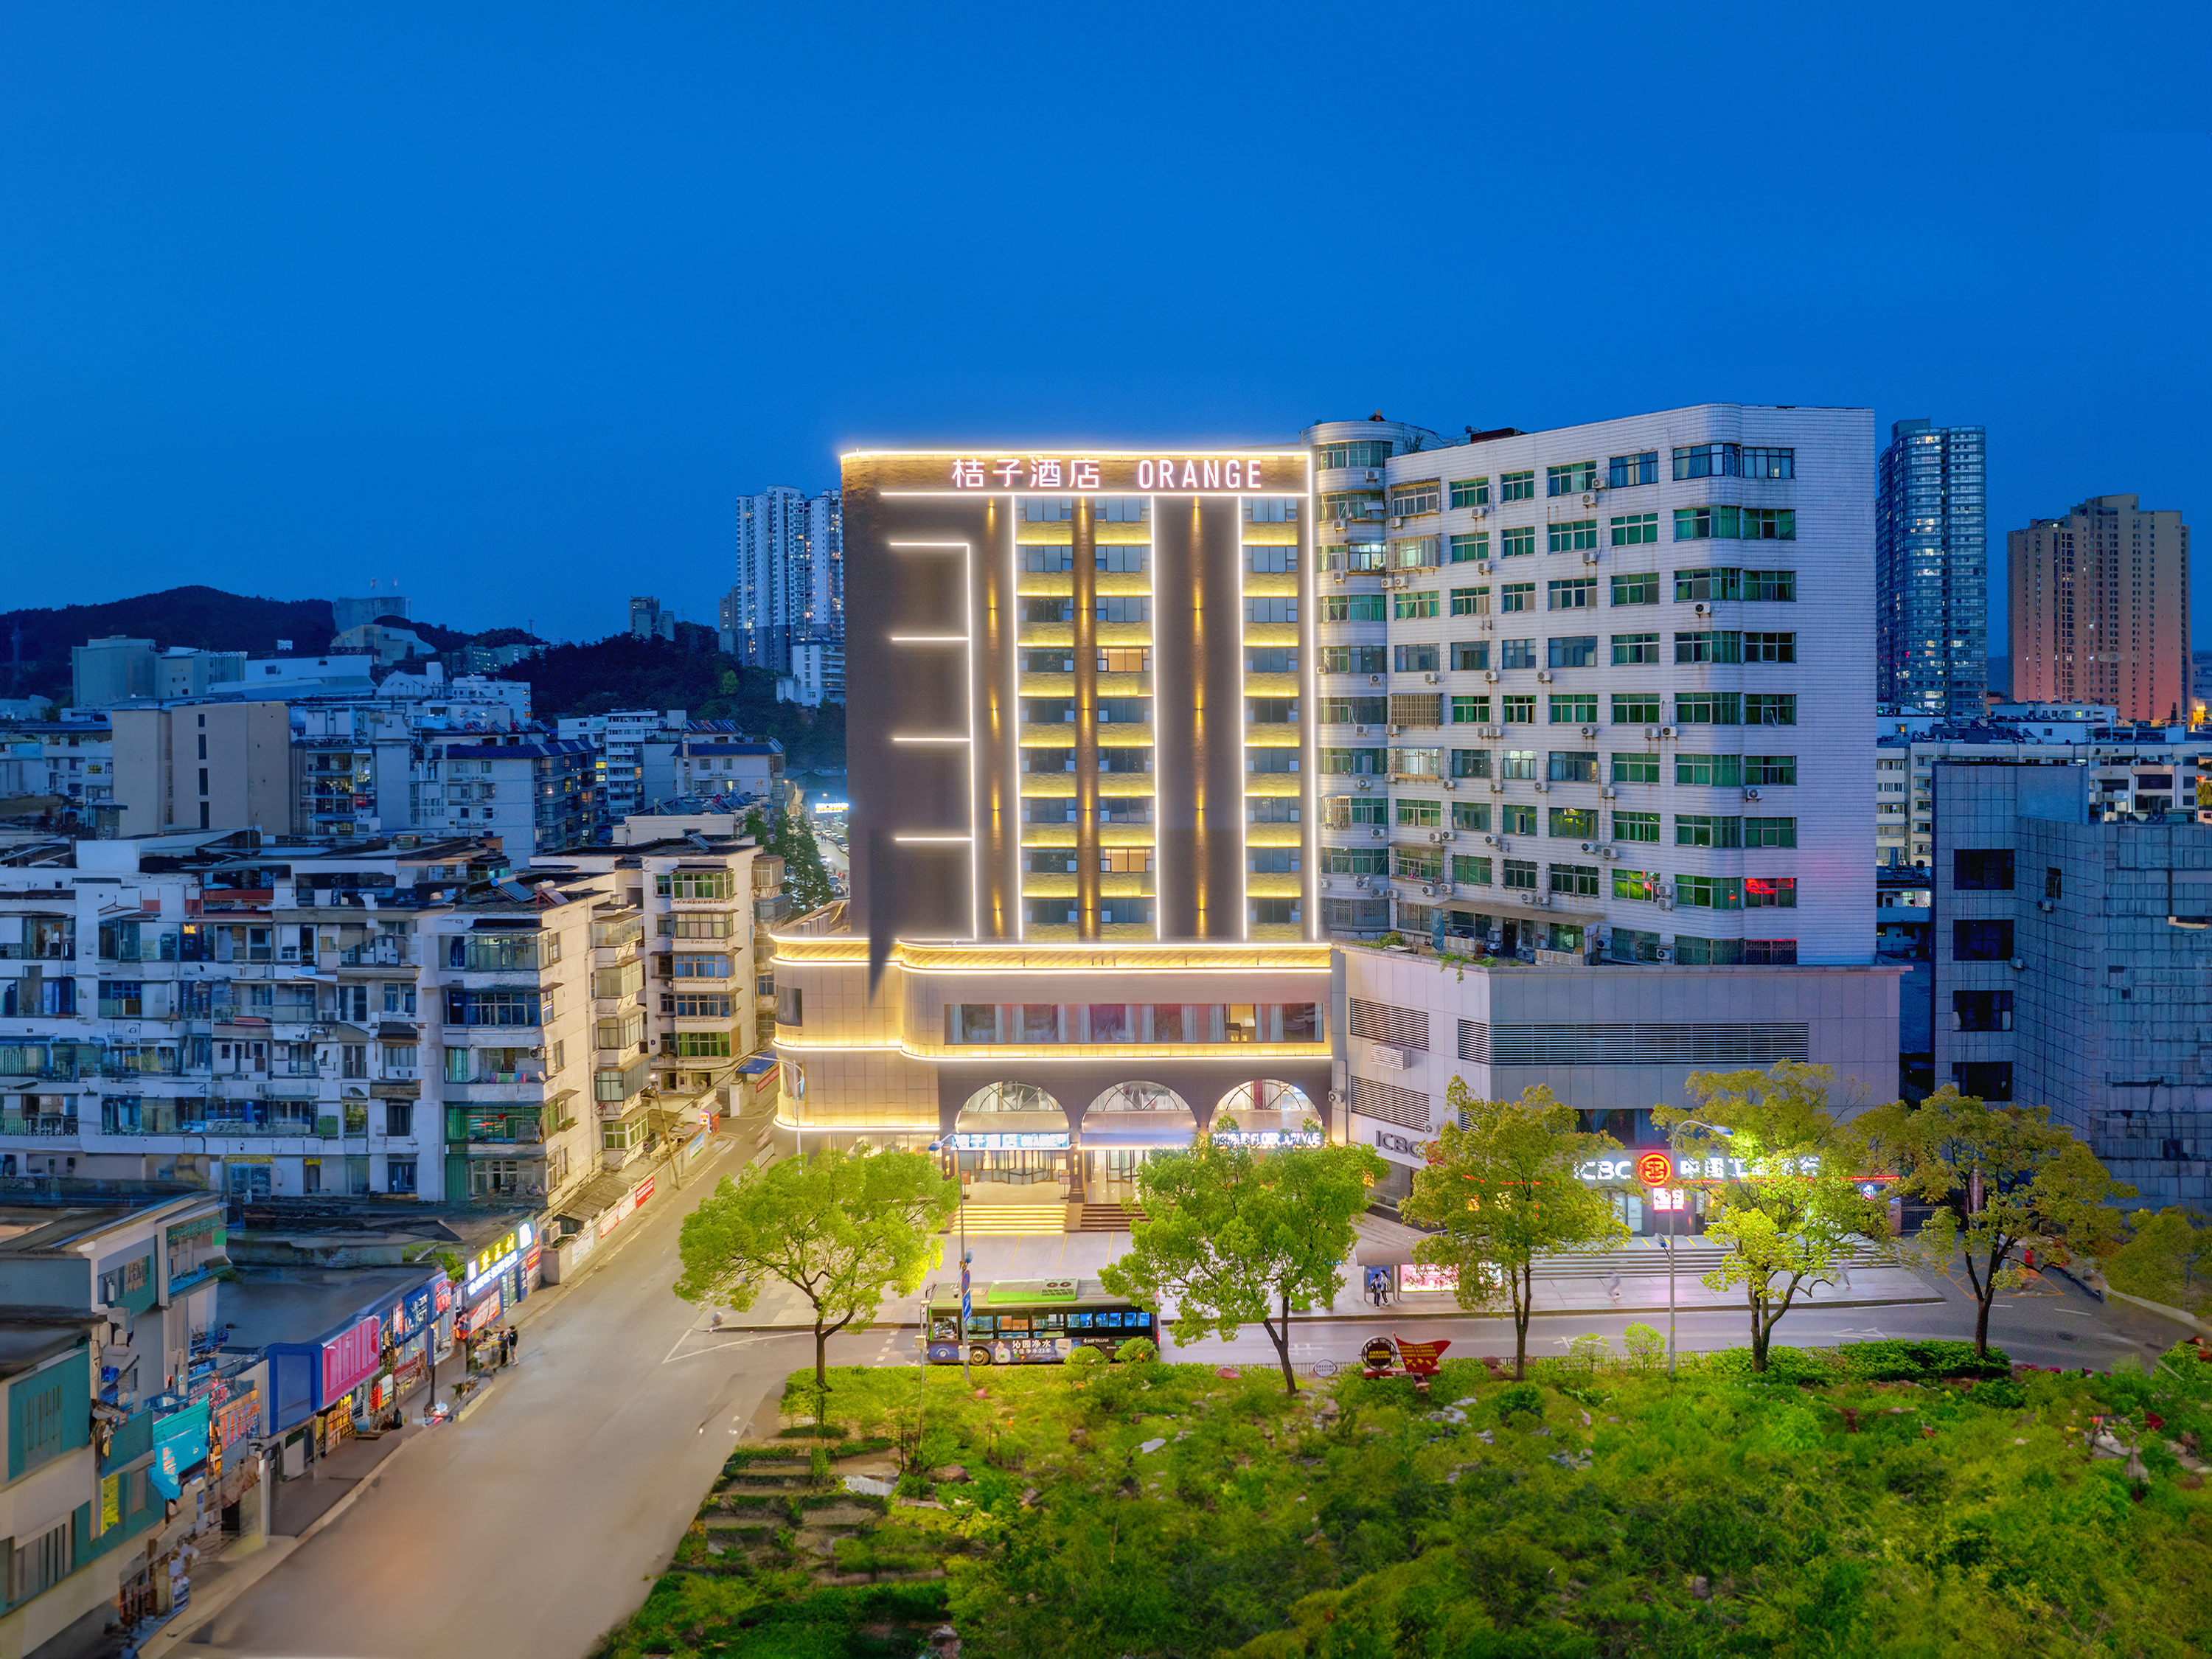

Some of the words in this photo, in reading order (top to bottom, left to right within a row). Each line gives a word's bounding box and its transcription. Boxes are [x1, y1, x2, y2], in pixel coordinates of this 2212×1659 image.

[952, 459, 1100, 488] 桔子酒店
[1138, 459, 1262, 488] ORANGE
[1376, 1130, 1420, 1158] ICBC
[1573, 1161, 1631, 1180] ICBC
